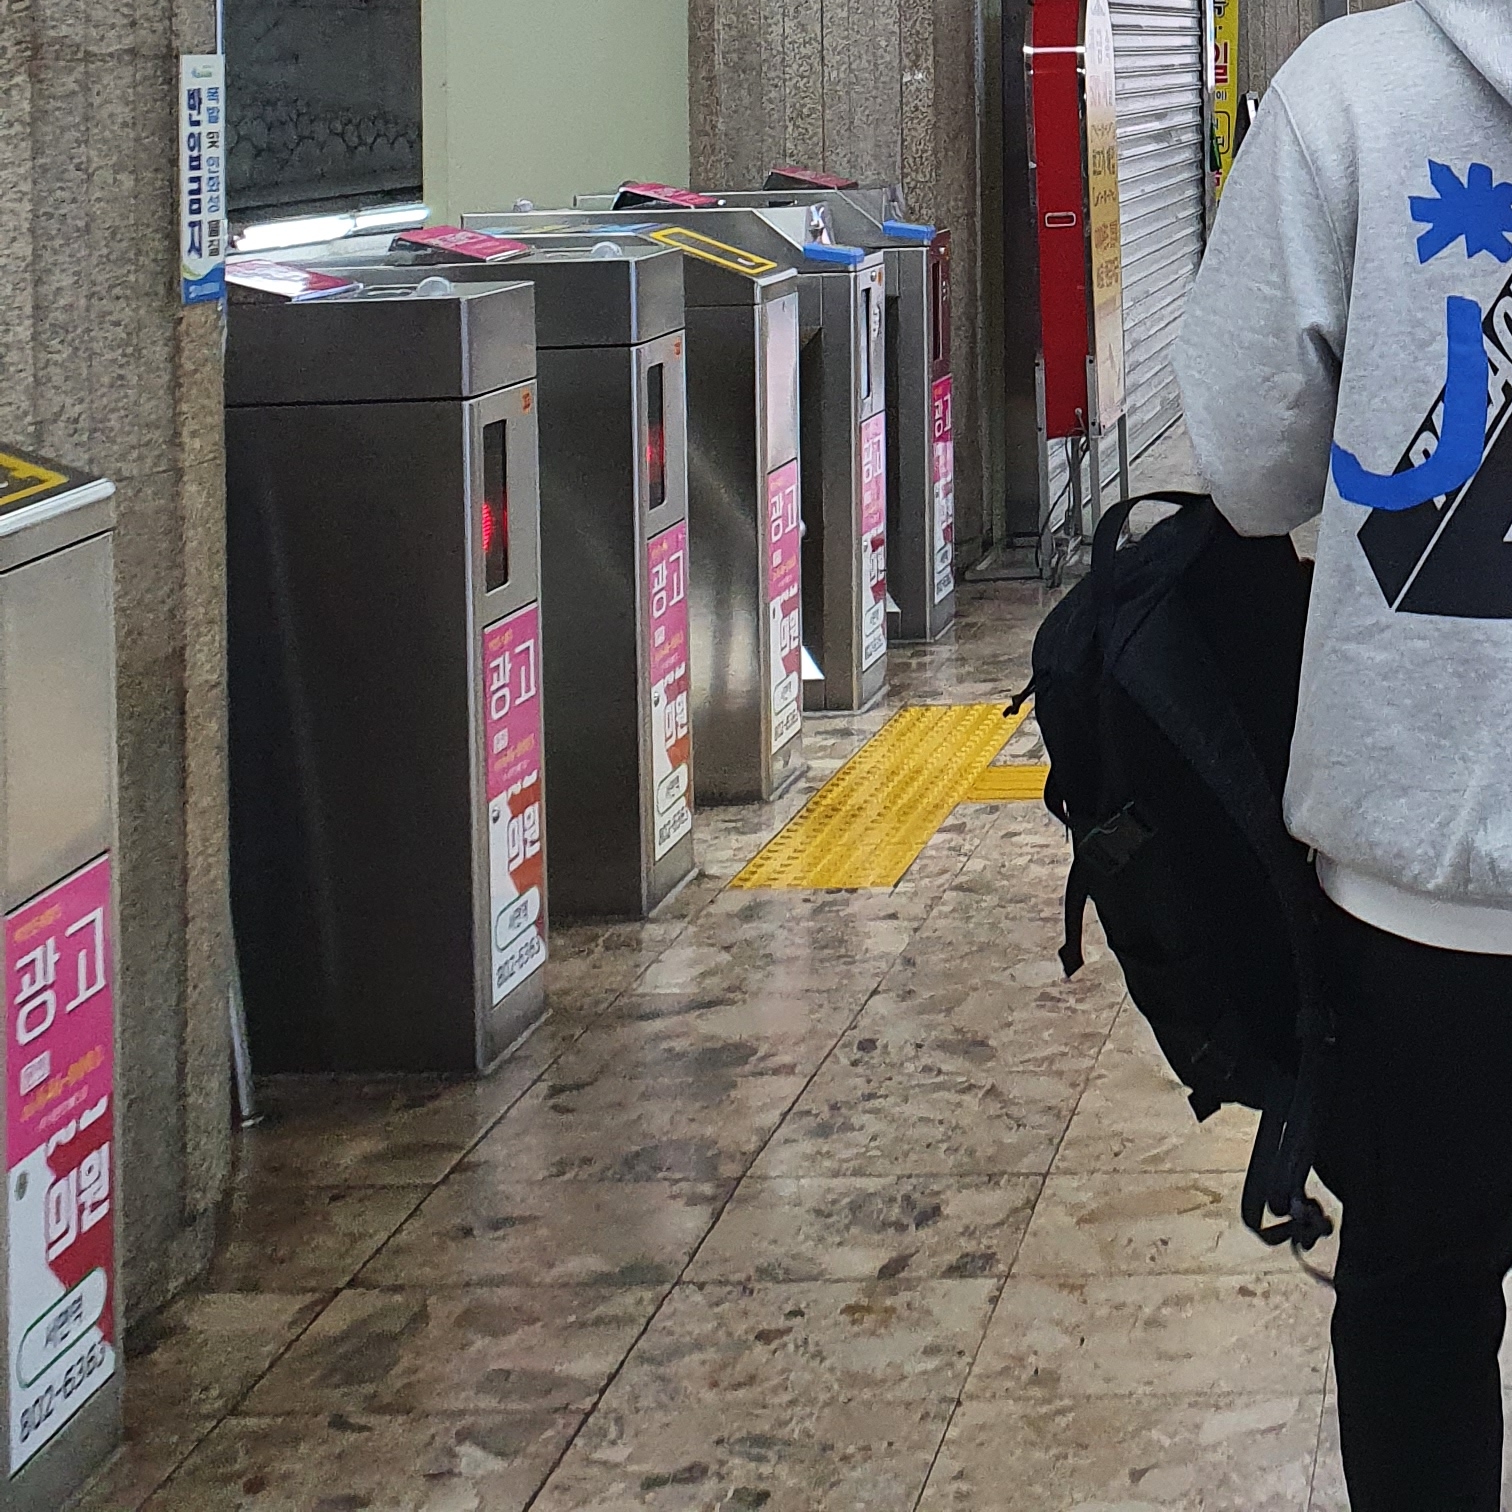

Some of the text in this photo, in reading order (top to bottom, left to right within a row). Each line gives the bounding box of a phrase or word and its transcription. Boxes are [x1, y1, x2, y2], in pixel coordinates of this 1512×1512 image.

[771, 484, 798, 543] 광고
[652, 550, 685, 619] 광고
[490, 638, 537, 721] 광고
[664, 690, 689, 750] 의원
[508, 801, 541, 872] 의원
[14, 906, 107, 1047] 광고
[48, 1142, 110, 1263] 의원
